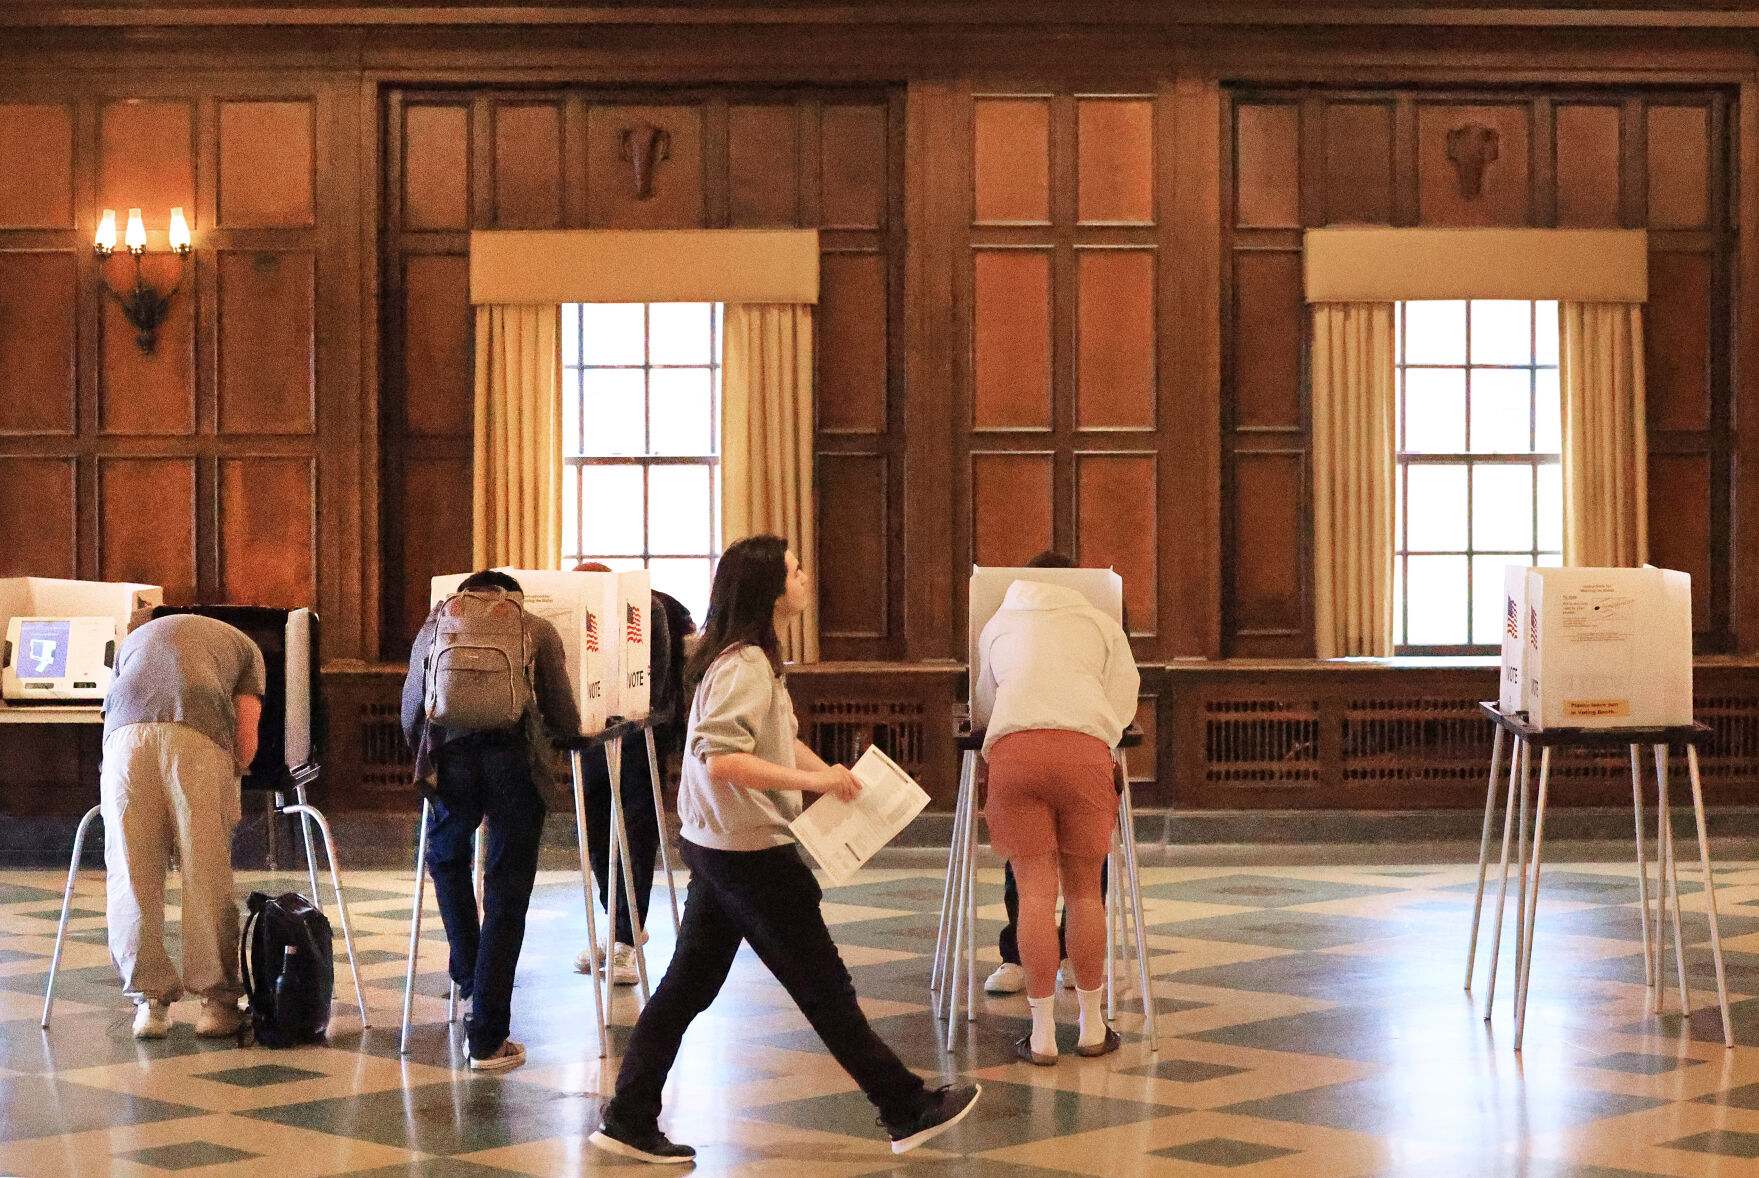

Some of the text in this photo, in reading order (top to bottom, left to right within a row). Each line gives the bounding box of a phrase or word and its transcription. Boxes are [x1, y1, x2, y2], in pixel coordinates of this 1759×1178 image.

[627, 670, 644, 689] VOTE
[1506, 665, 1518, 685] VOTE
[588, 680, 601, 699] VOTE
